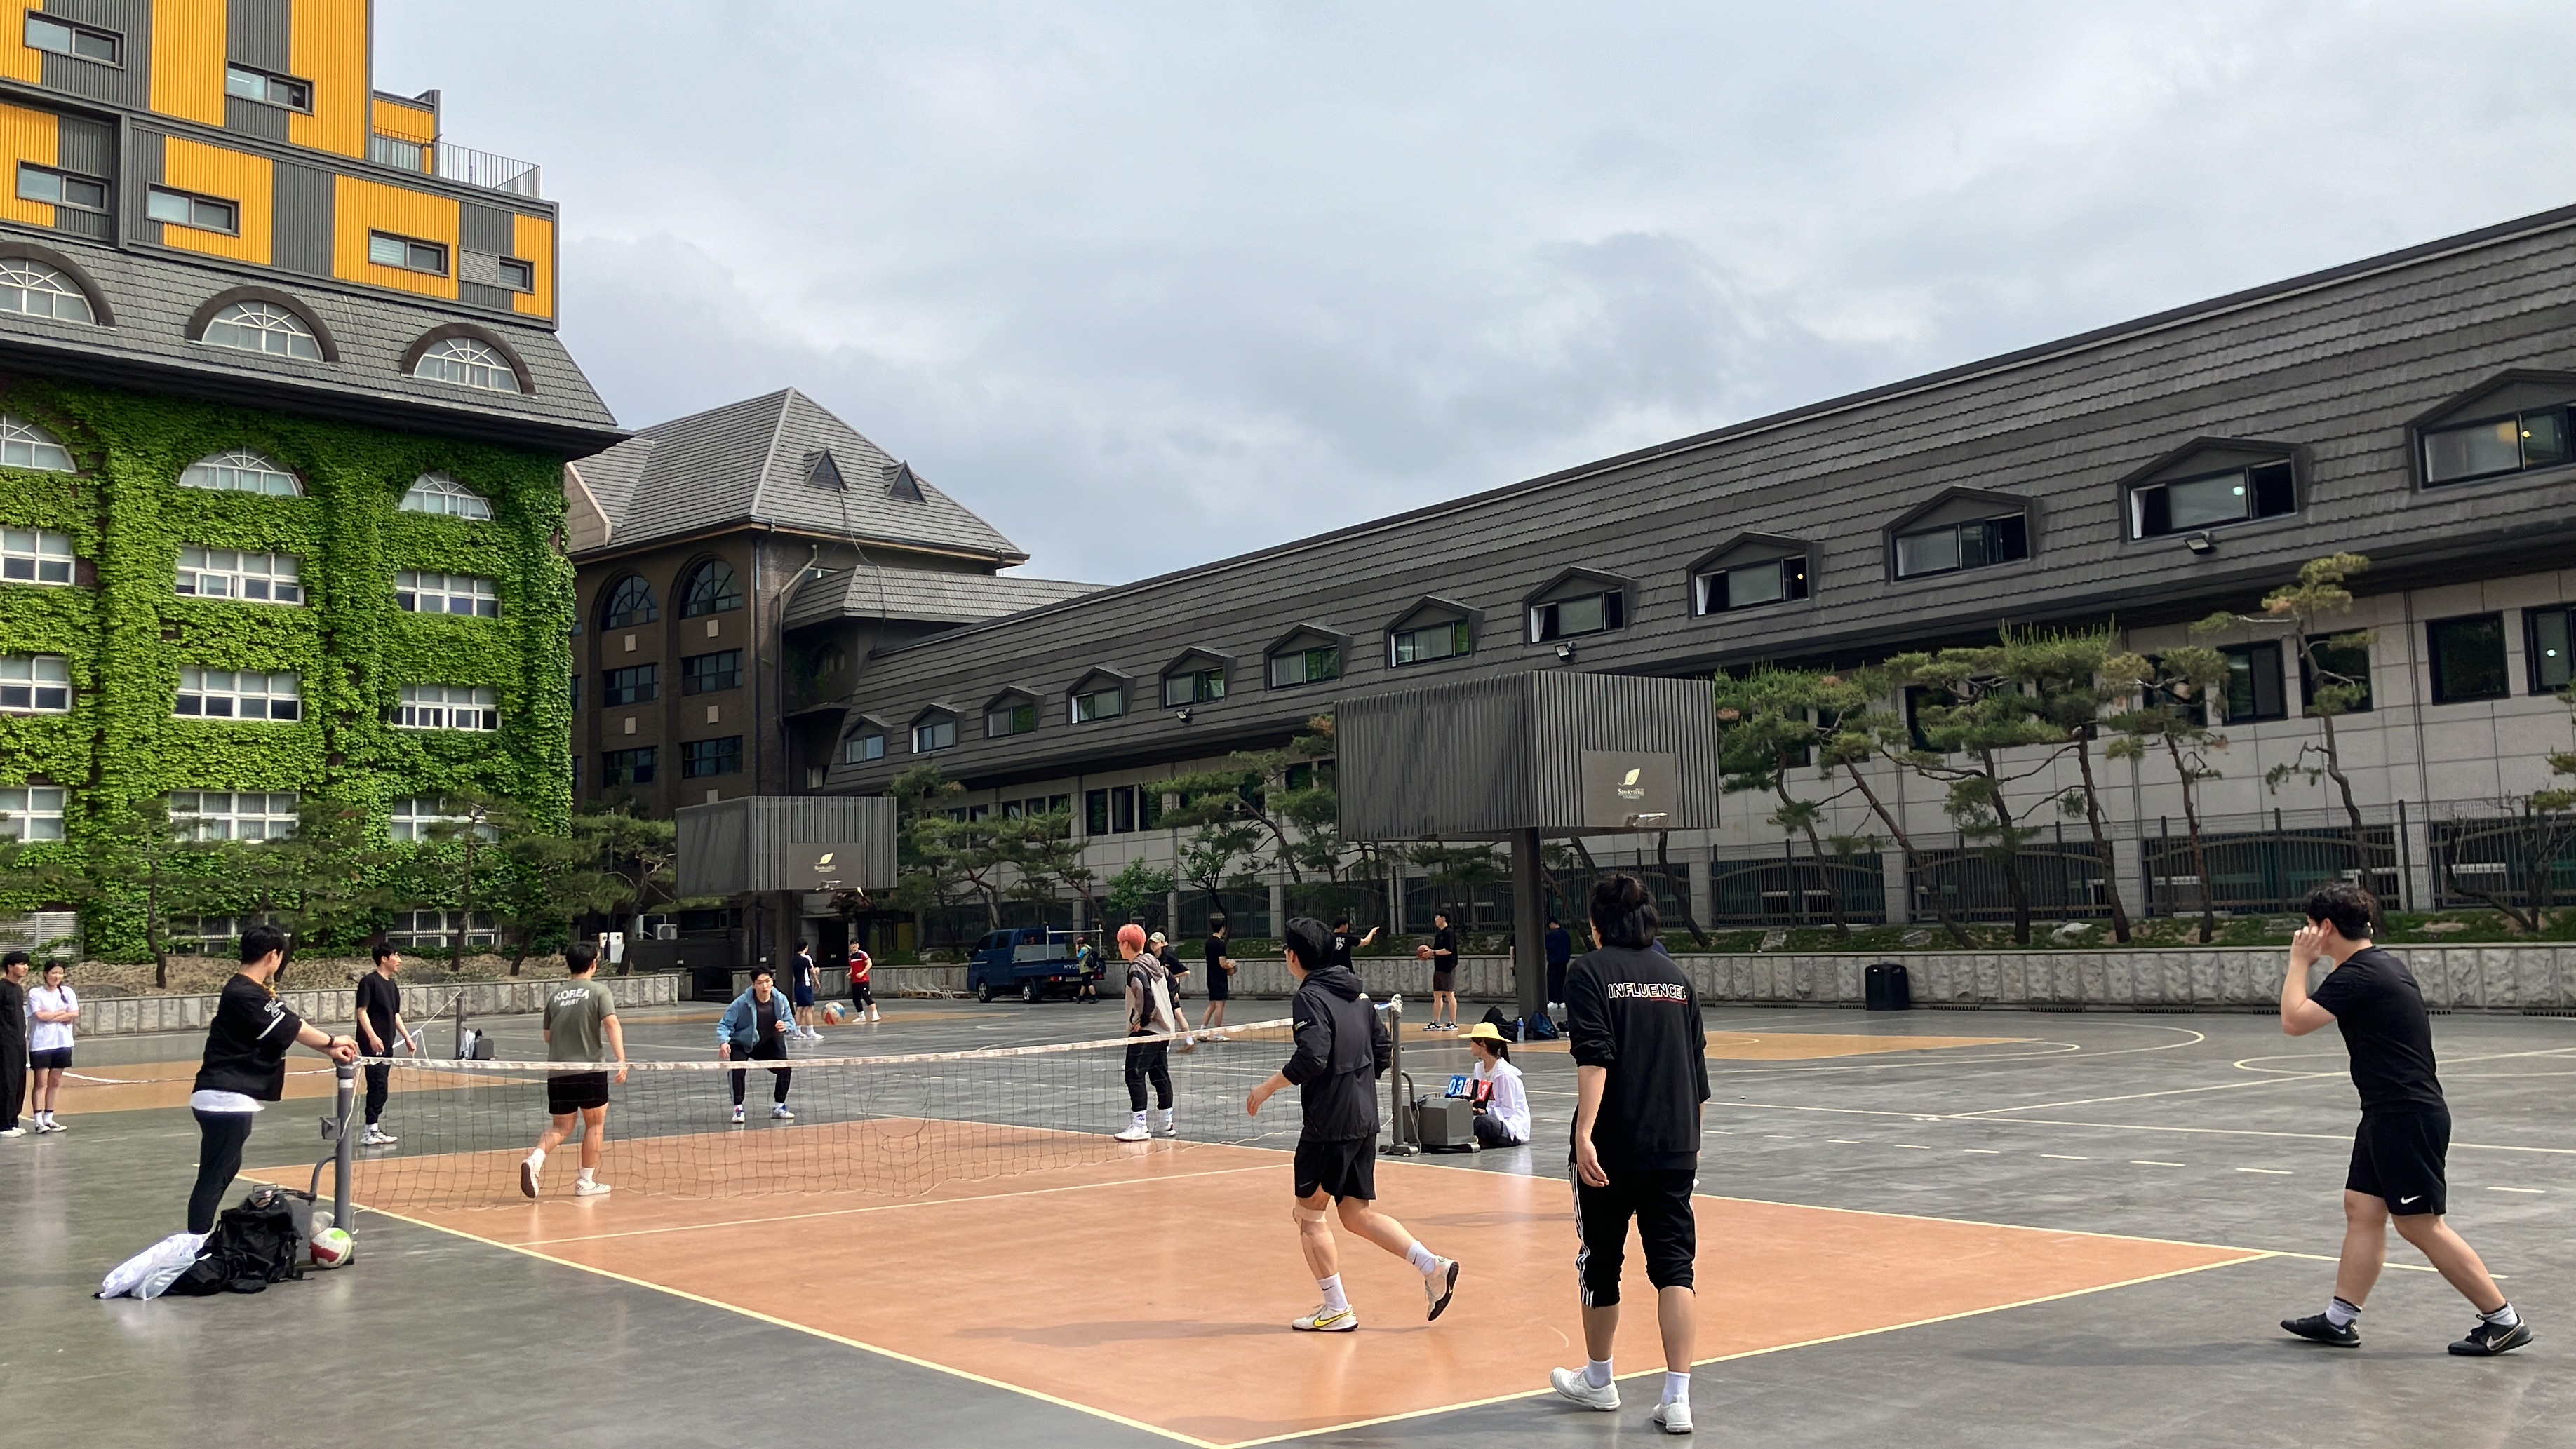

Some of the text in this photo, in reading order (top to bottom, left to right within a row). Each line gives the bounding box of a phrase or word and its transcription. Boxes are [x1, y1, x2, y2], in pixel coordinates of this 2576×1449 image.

[554, 988, 589, 1002] KOREA
[560, 998, 579, 1006] ARMY
[1448, 1078, 1464, 1095] 03
[1478, 1084, 1488, 1100] 3
